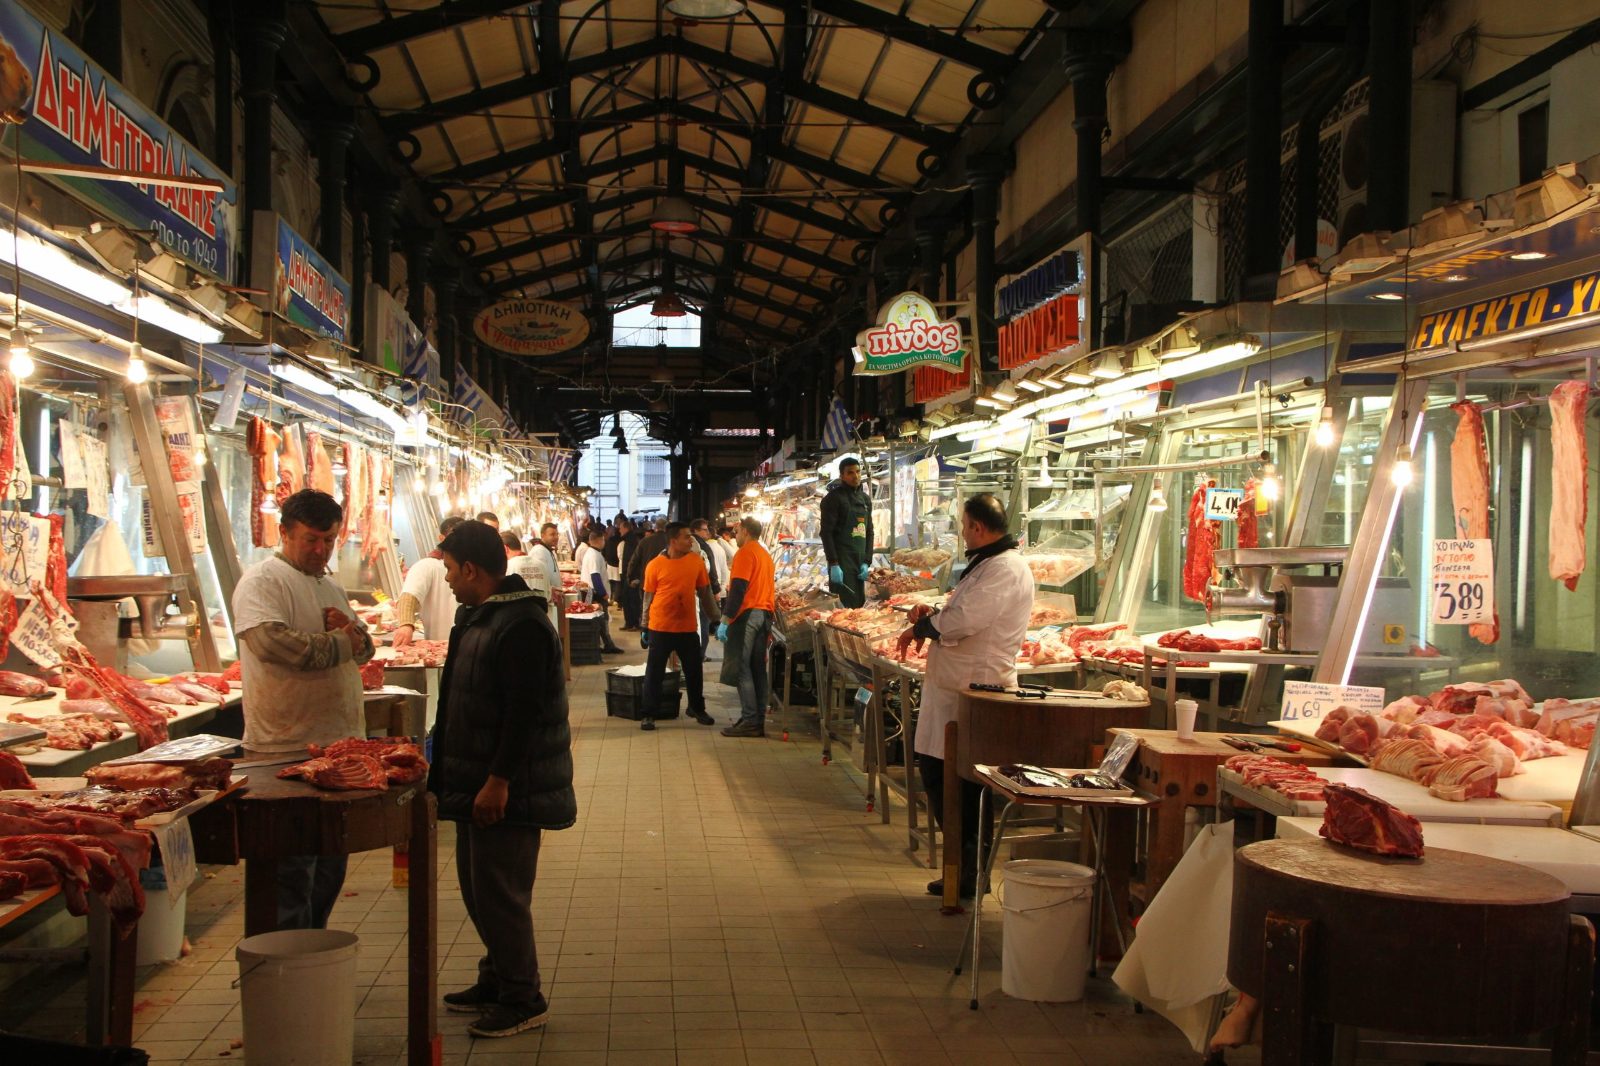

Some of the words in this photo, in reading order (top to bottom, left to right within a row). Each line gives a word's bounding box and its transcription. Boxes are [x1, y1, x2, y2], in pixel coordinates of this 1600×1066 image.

[33, 26, 217, 241] ΔΗΜΗΤΡΙΑΔΗΣ
[192, 237, 217, 274] 1942
[287, 236, 344, 330] ΔΗΜΗΤΡΙΑΔΗΣ
[493, 302, 572, 321] ΔΗΜΟΤΙΚΗ
[998, 294, 1072, 371] ΠΑΠΟΥΤΣΗ
